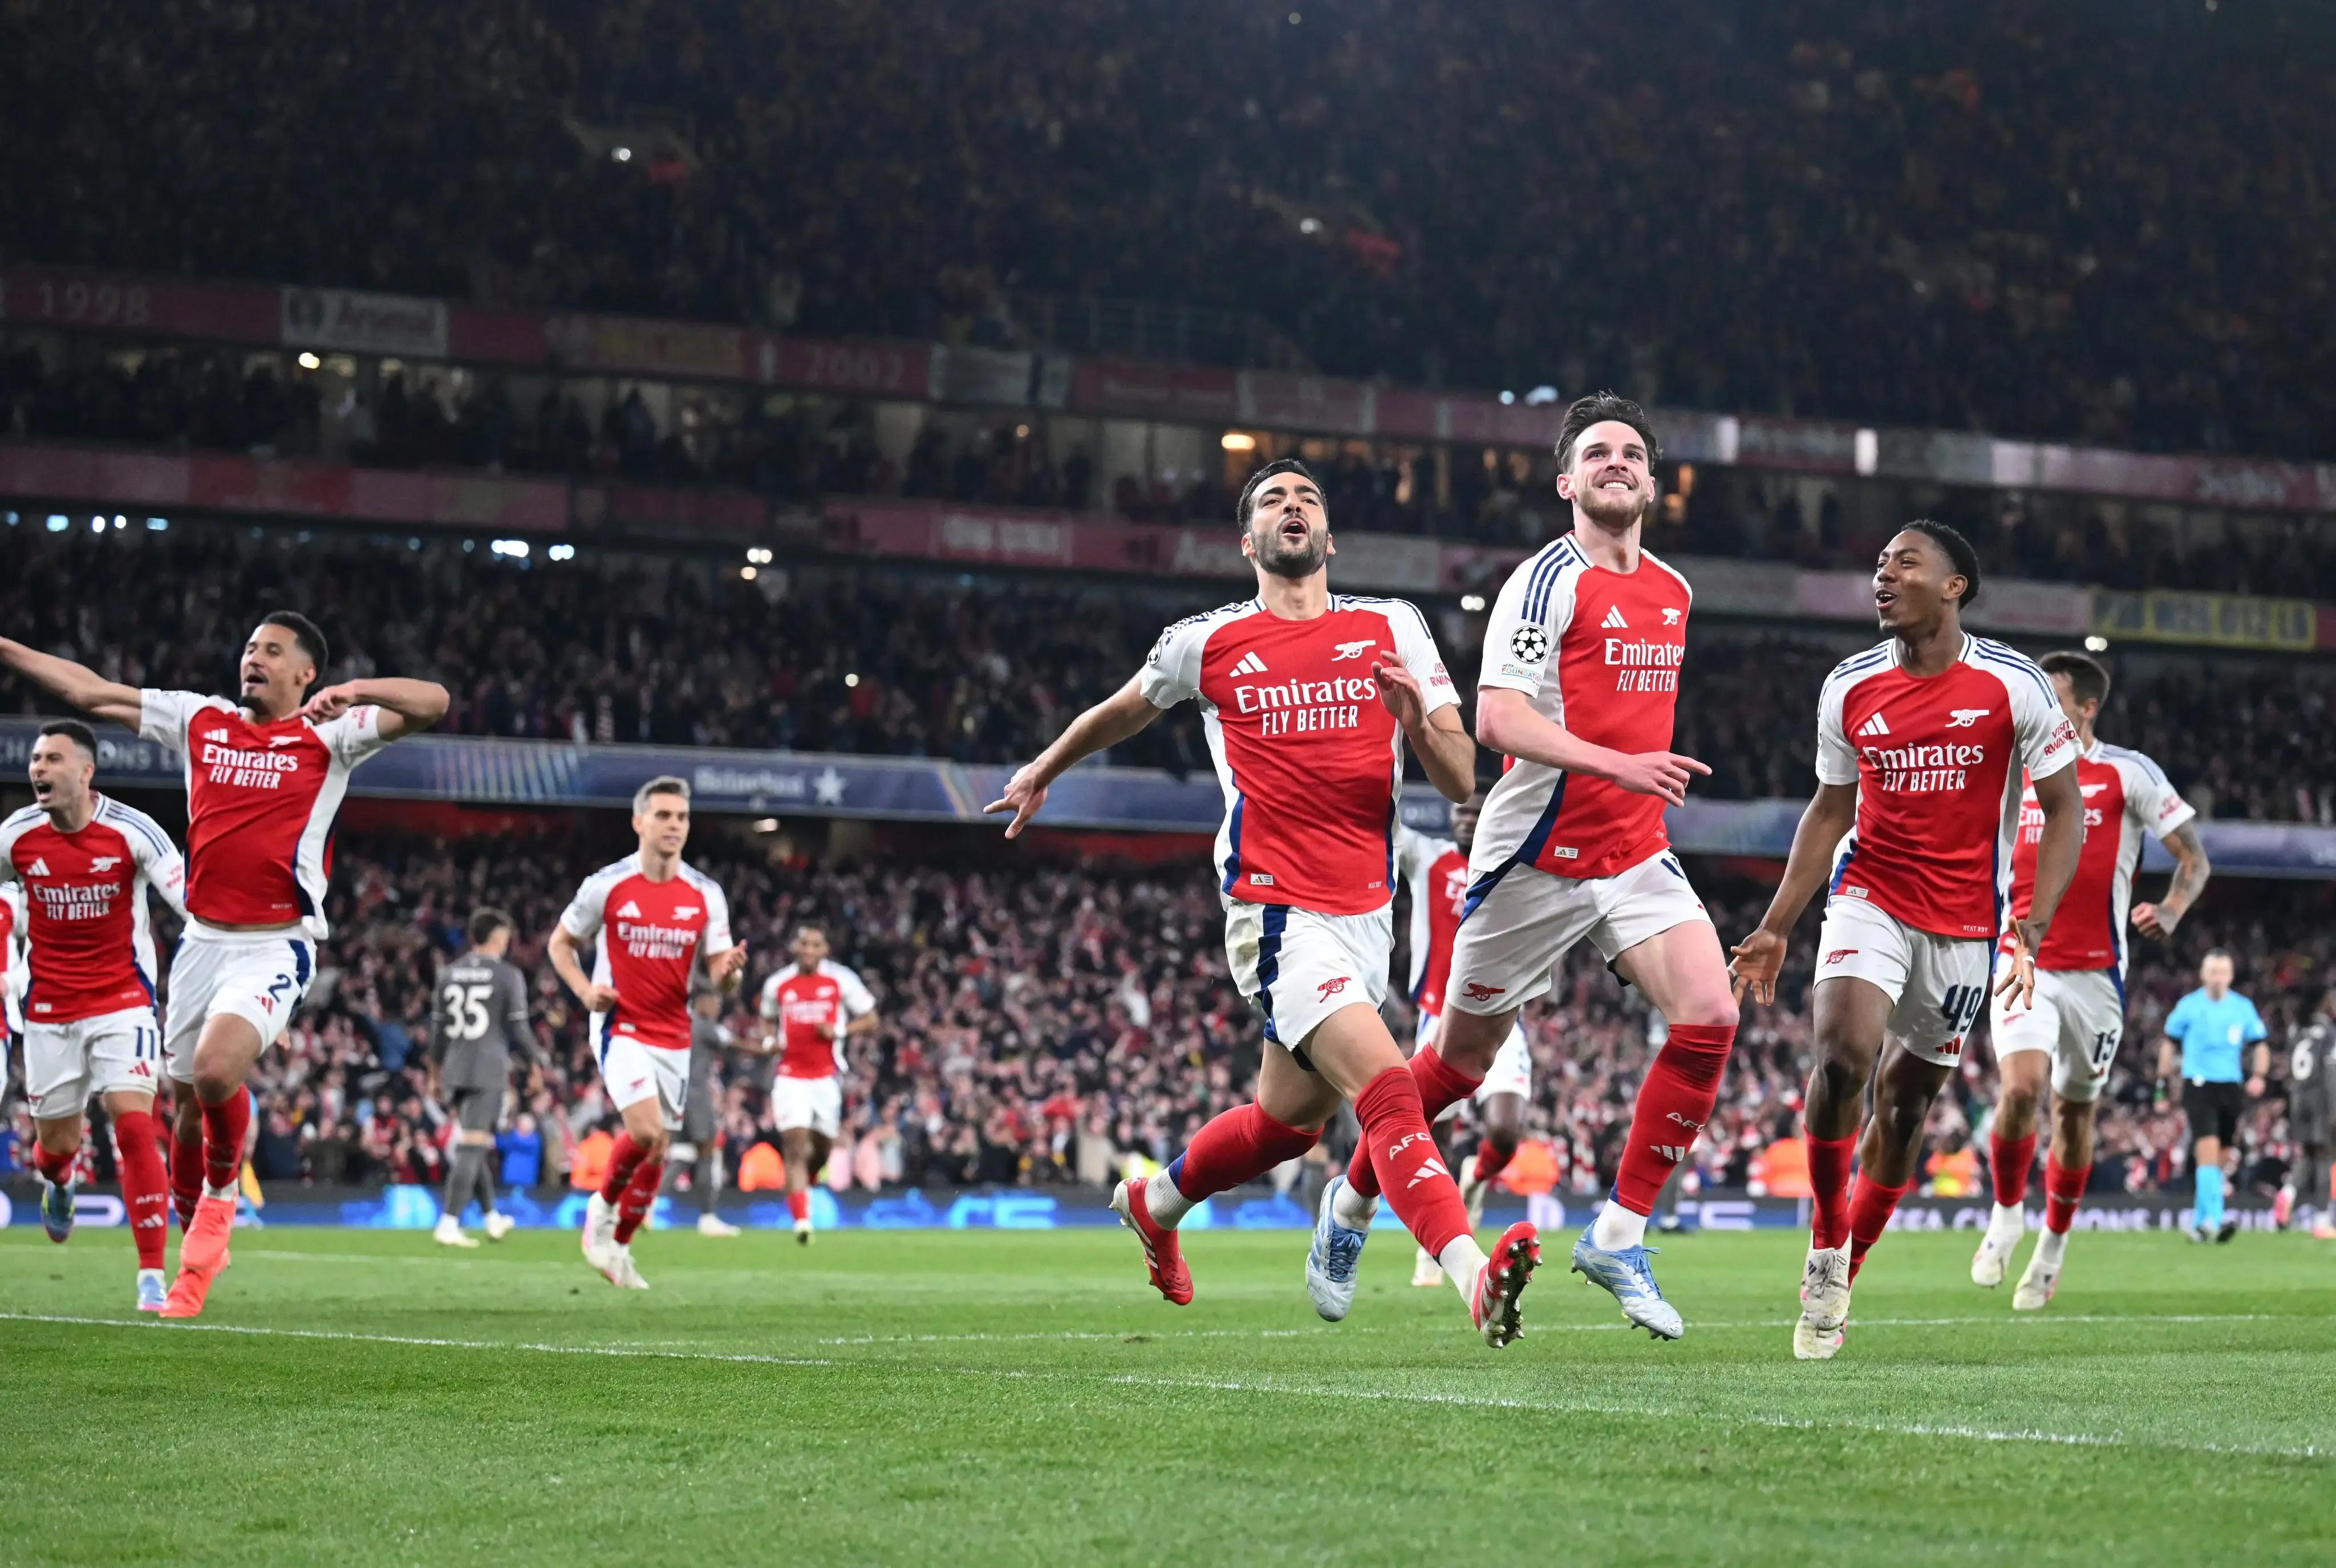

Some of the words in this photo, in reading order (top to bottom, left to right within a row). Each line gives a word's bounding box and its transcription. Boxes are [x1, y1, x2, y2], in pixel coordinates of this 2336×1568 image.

[39, 281, 151, 326] 1998
[807, 348, 905, 389] 2002
[1234, 675, 1376, 714] Emirates
[1616, 670, 1637, 692] FLY
[1637, 670, 1676, 692] BETTER
[1262, 710, 1290, 736] FLY
[1297, 705, 1358, 732] BETTER
[2052, 720, 2070, 739] VISIT
[202, 743, 299, 772] Emirates
[1863, 742, 1984, 770] Emirates
[209, 765, 233, 785] FLY
[233, 768, 281, 789] BETTER
[1883, 771, 1906, 791] FLY
[1910, 770, 1966, 791] BETTER
[33, 882, 121, 903] Emirates
[47, 903, 64, 920] FLY
[67, 901, 110, 920] BETTER
[618, 921, 697, 946] Emirates
[1963, 925, 1988, 933] HEAT.RDY
[268, 973, 292, 1004] 2
[444, 984, 493, 1041] 35
[1941, 984, 1982, 1032] 49
[135, 1026, 155, 1061] 11
[2092, 1029, 2116, 1064] 15
[2292, 1039, 2313, 1081] 6
[1389, 1132, 1430, 1160] AFC
[136, 1193, 164, 1205] AFC
